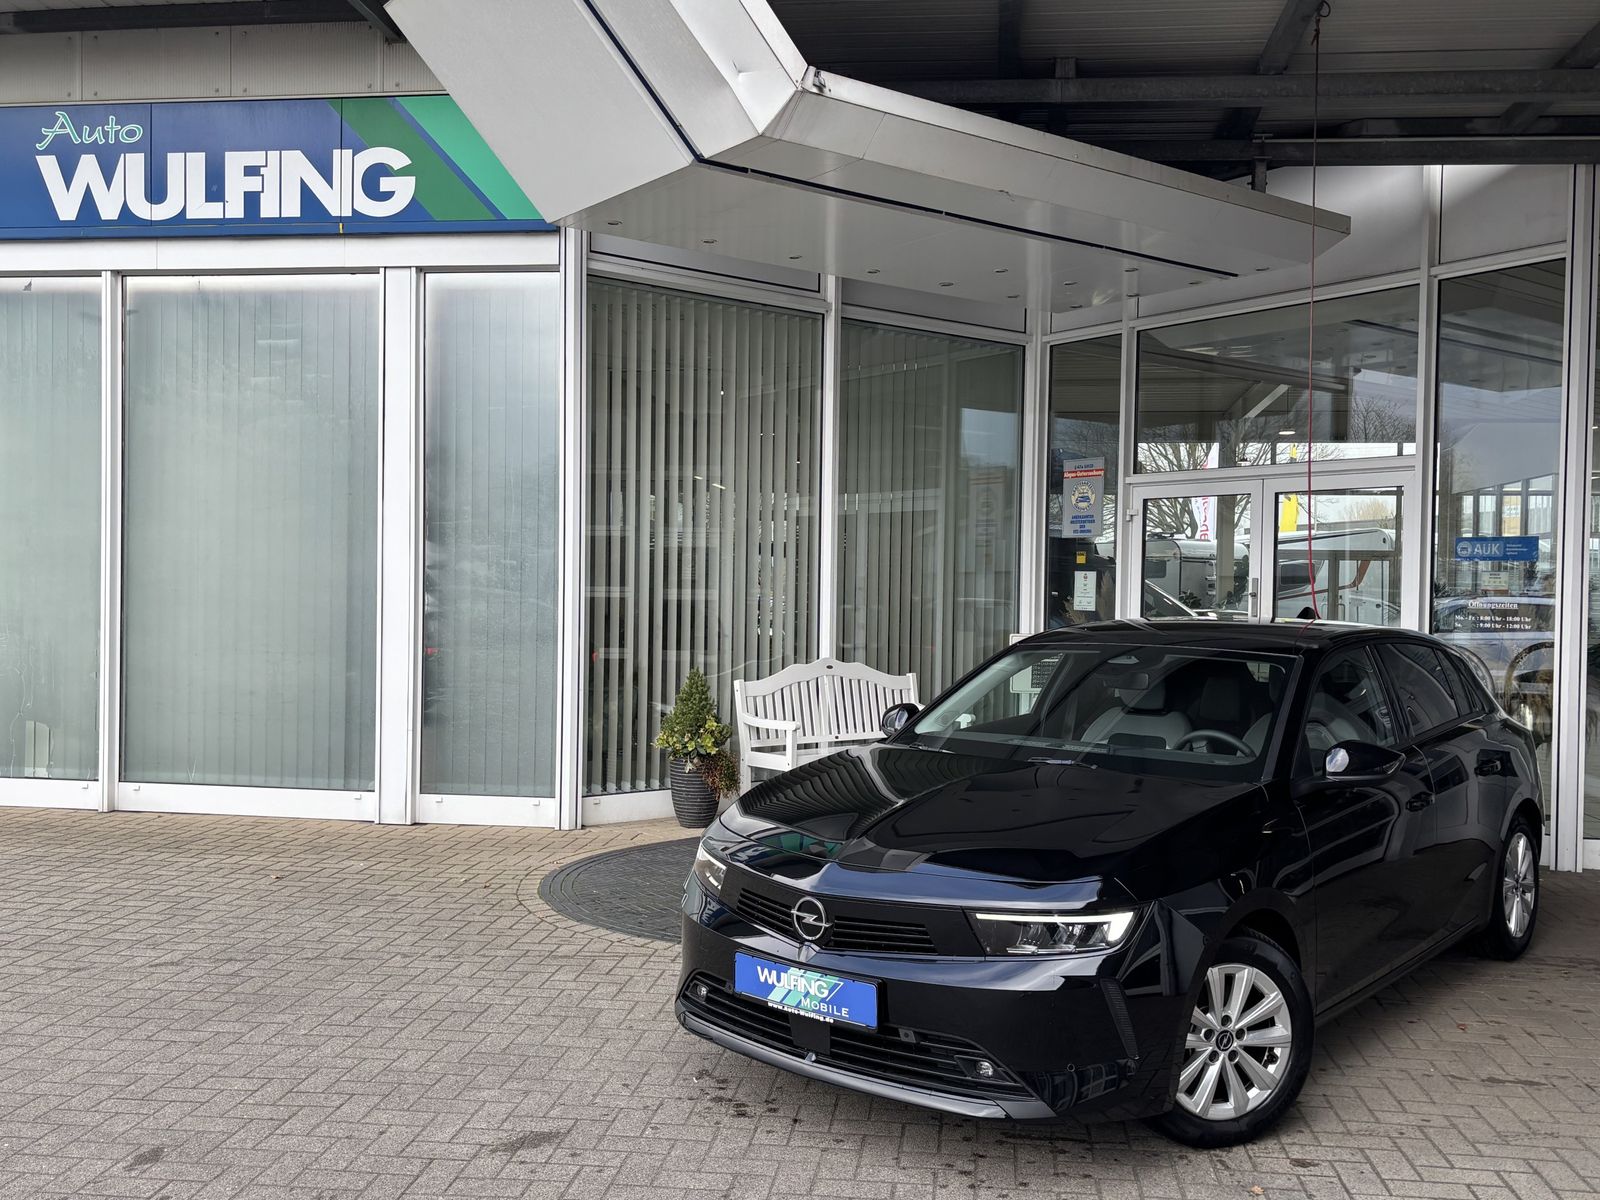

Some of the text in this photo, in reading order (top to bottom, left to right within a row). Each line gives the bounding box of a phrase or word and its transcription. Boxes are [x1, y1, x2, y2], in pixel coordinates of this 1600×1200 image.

[36, 111, 144, 151] Auto
[35, 146, 416, 221] WULFING
[756, 965, 830, 998] WULFING
[801, 996, 849, 1018] MOBILE
